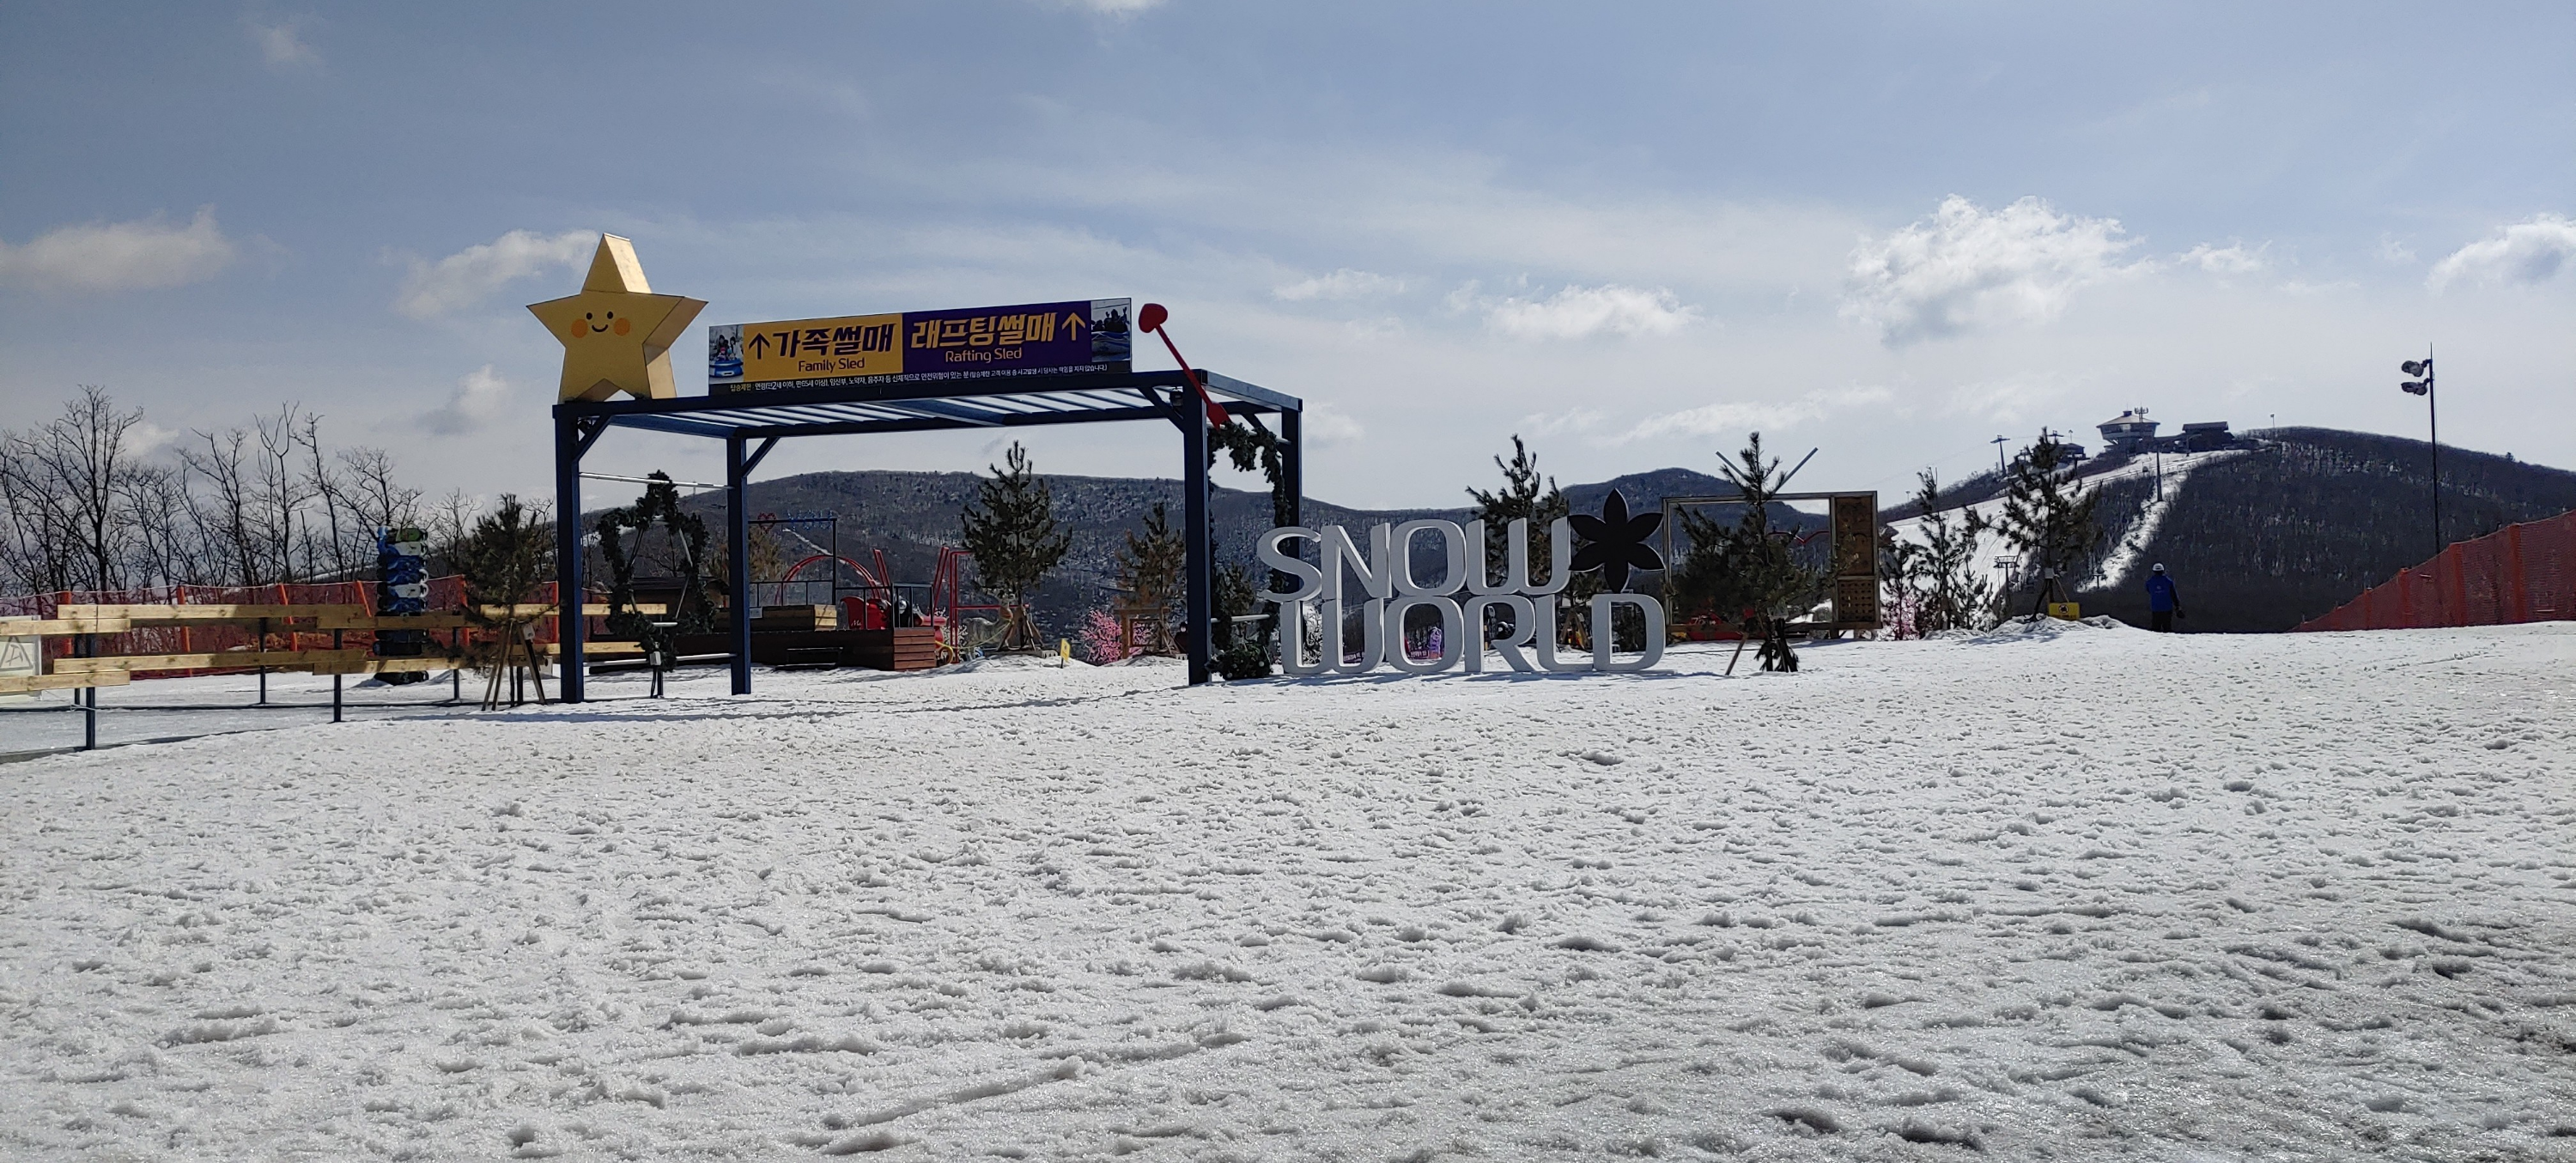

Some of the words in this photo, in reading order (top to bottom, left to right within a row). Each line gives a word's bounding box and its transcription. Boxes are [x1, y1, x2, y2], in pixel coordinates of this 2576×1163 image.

[773, 323, 896, 358] 가족썰매
[911, 312, 1058, 348] 래프팅썰매
[799, 359, 835, 373] Family
[839, 357, 865, 370] Sled
[945, 349, 992, 363] Rafting
[994, 348, 1022, 360] Sled
[885, 375, 891, 384] 등
[1256, 518, 1571, 603] SNOW
[1279, 592, 1666, 674] WORLD
